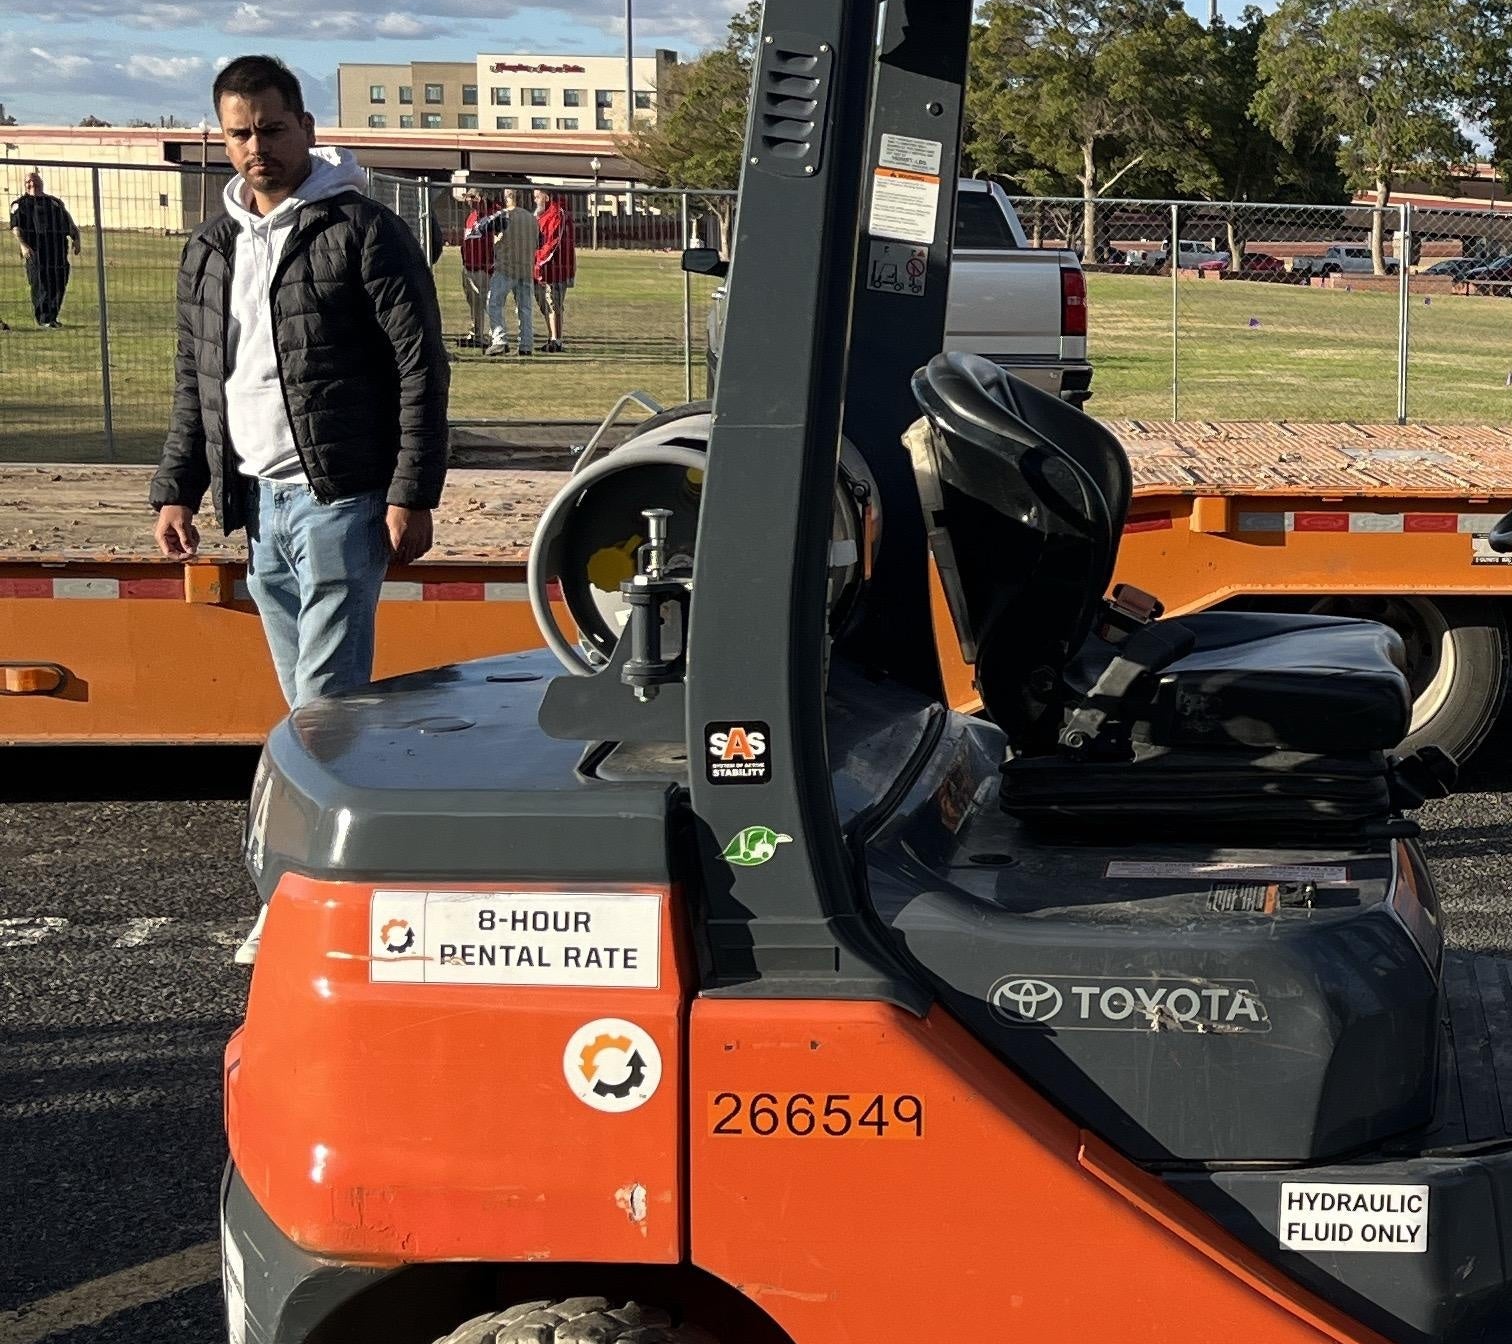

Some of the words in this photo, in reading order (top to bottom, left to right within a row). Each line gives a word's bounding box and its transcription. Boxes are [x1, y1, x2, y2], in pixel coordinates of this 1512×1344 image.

[709, 727, 766, 761] SAS
[711, 768, 766, 777] STABILITY
[478, 909, 592, 933] 8-HOUR
[440, 944, 552, 968] RENTAL
[564, 946, 638, 969] RATE
[1071, 986, 1260, 1022] TOYOTA
[713, 1092, 923, 1138] 266549
[1287, 1192, 1423, 1214] HYDRAULIC
[1287, 1222, 1354, 1242] FLUID
[1361, 1223, 1421, 1244] ONLY
